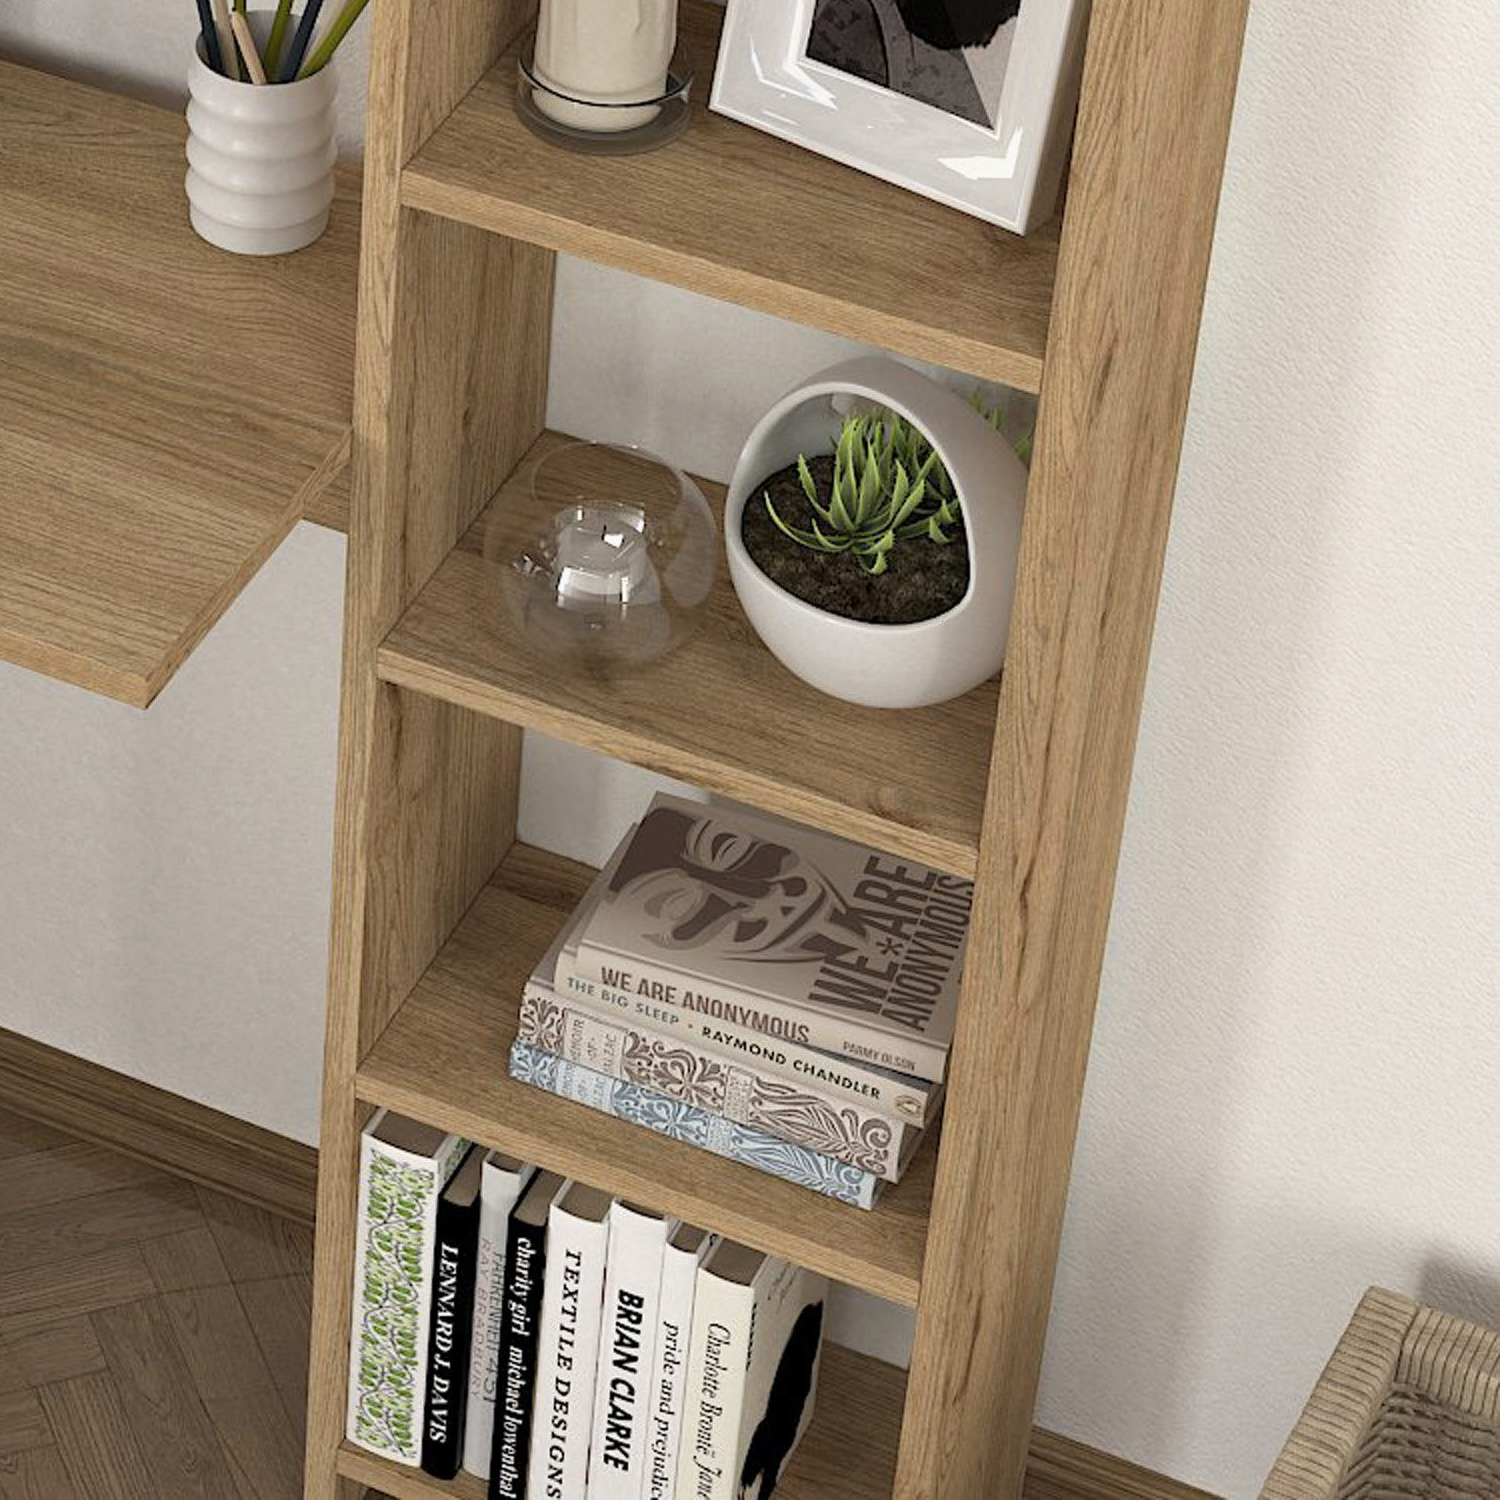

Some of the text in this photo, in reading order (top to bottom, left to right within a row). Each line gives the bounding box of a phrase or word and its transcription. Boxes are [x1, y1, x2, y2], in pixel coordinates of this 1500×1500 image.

[567, 977, 680, 1025] THE BIG SLEEP
[600, 966, 810, 1043] WE ARE ANONYMOUS
[808, 855, 938, 1015] WE ARE
[881, 875, 975, 1032] ANONYMOUS
[702, 1026, 787, 1066] RAYMOND
[793, 1059, 882, 1100] CHANDLER
[429, 1242, 459, 1444] LENNARD J. DAVIS
[470, 1237, 492, 1399] RAY BRADBURY
[508, 1237, 536, 1337] charity girl
[701, 1323, 732, 1399] Charlotte
[499, 1345, 527, 1500] michael lowenthal
[546, 1249, 582, 1500] TEXTILE DESIGNS
[603, 1289, 645, 1472] BRIAN CLARKE
[650, 1320, 682, 1500] pride and prejudic
